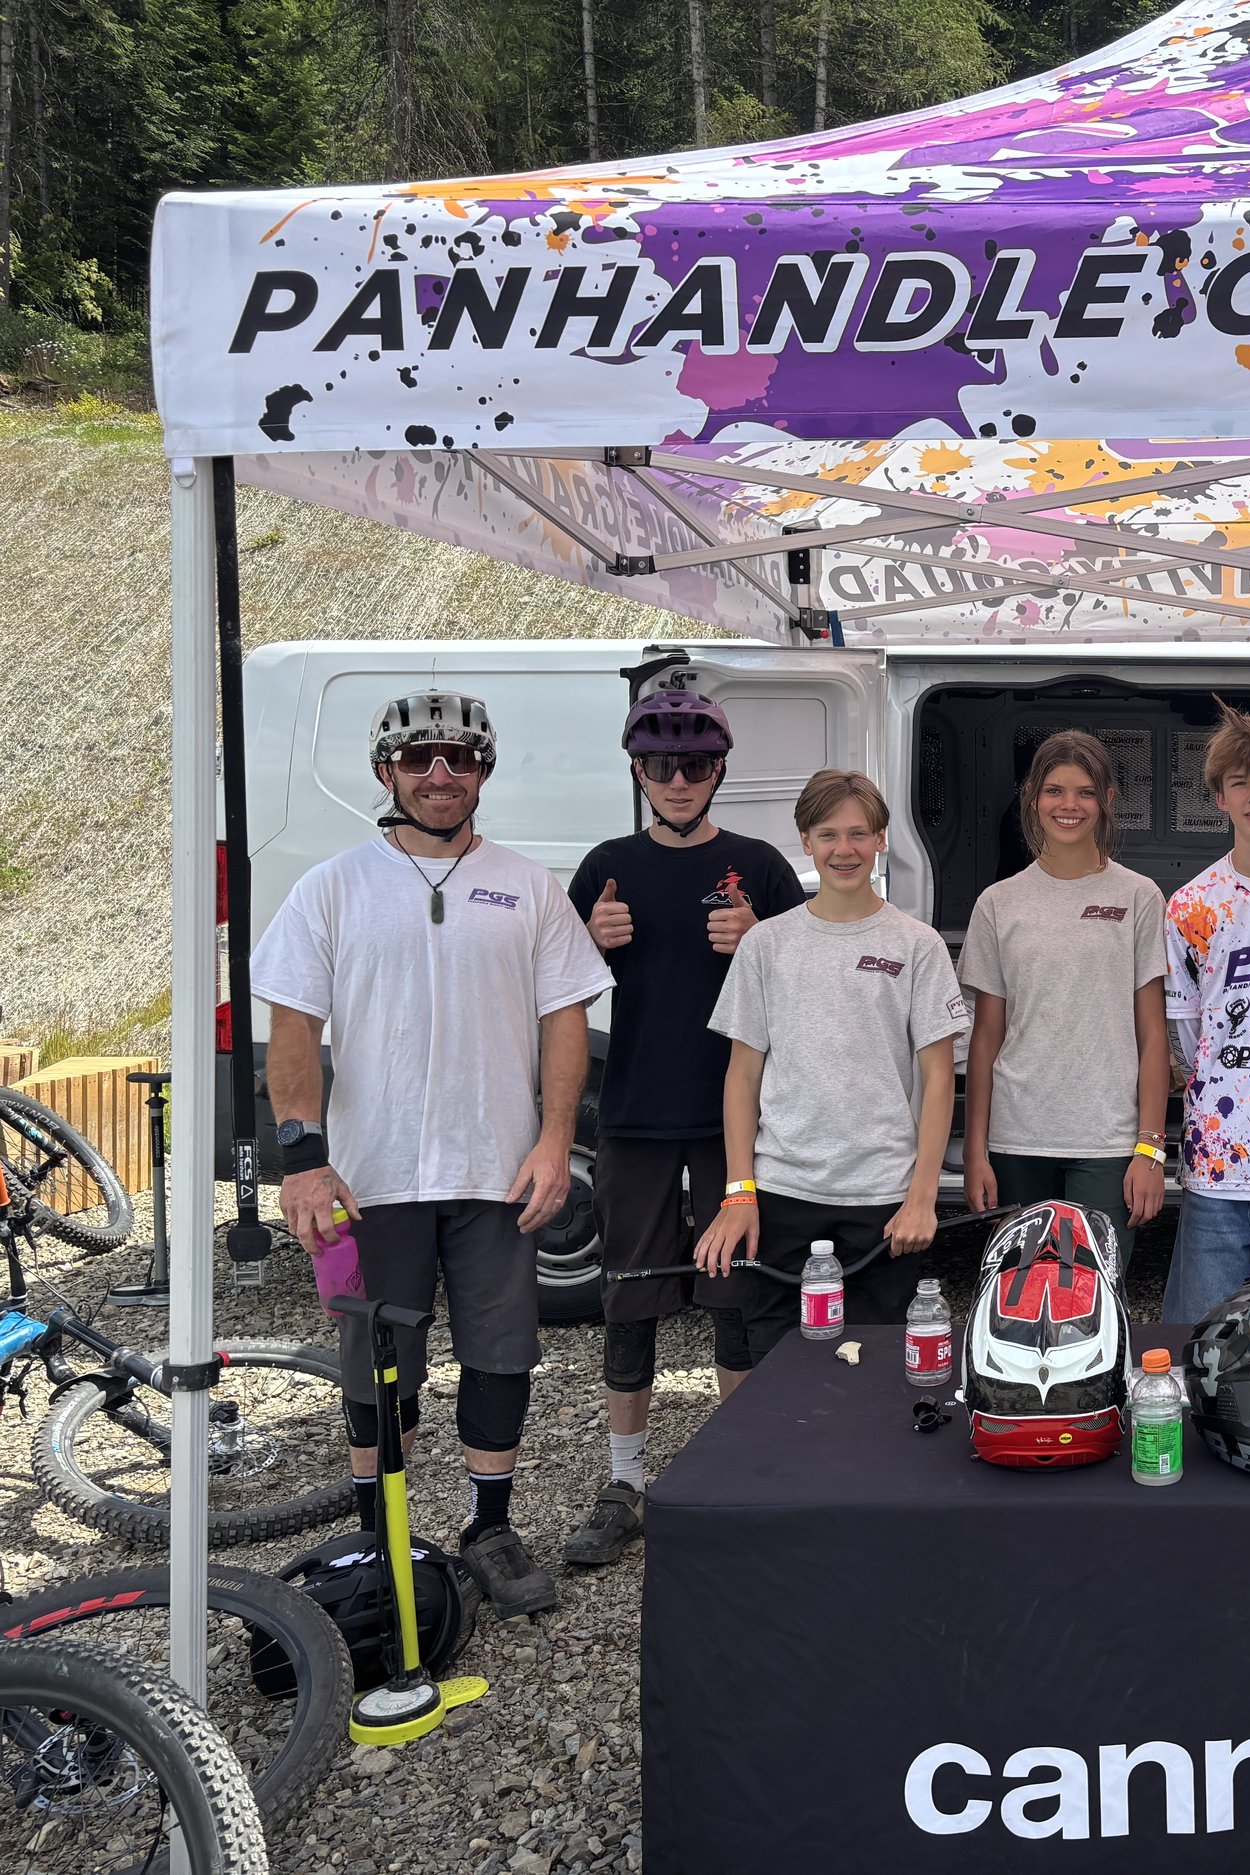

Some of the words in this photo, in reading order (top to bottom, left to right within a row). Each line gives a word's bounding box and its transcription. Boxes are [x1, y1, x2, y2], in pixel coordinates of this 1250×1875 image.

[230, 252, 1148, 354] PANHANDLE
[469, 888, 520, 908] PGS
[1083, 905, 1128, 921] PGS
[857, 955, 905, 977] PGS
[244, 1145, 253, 1181] FCS
